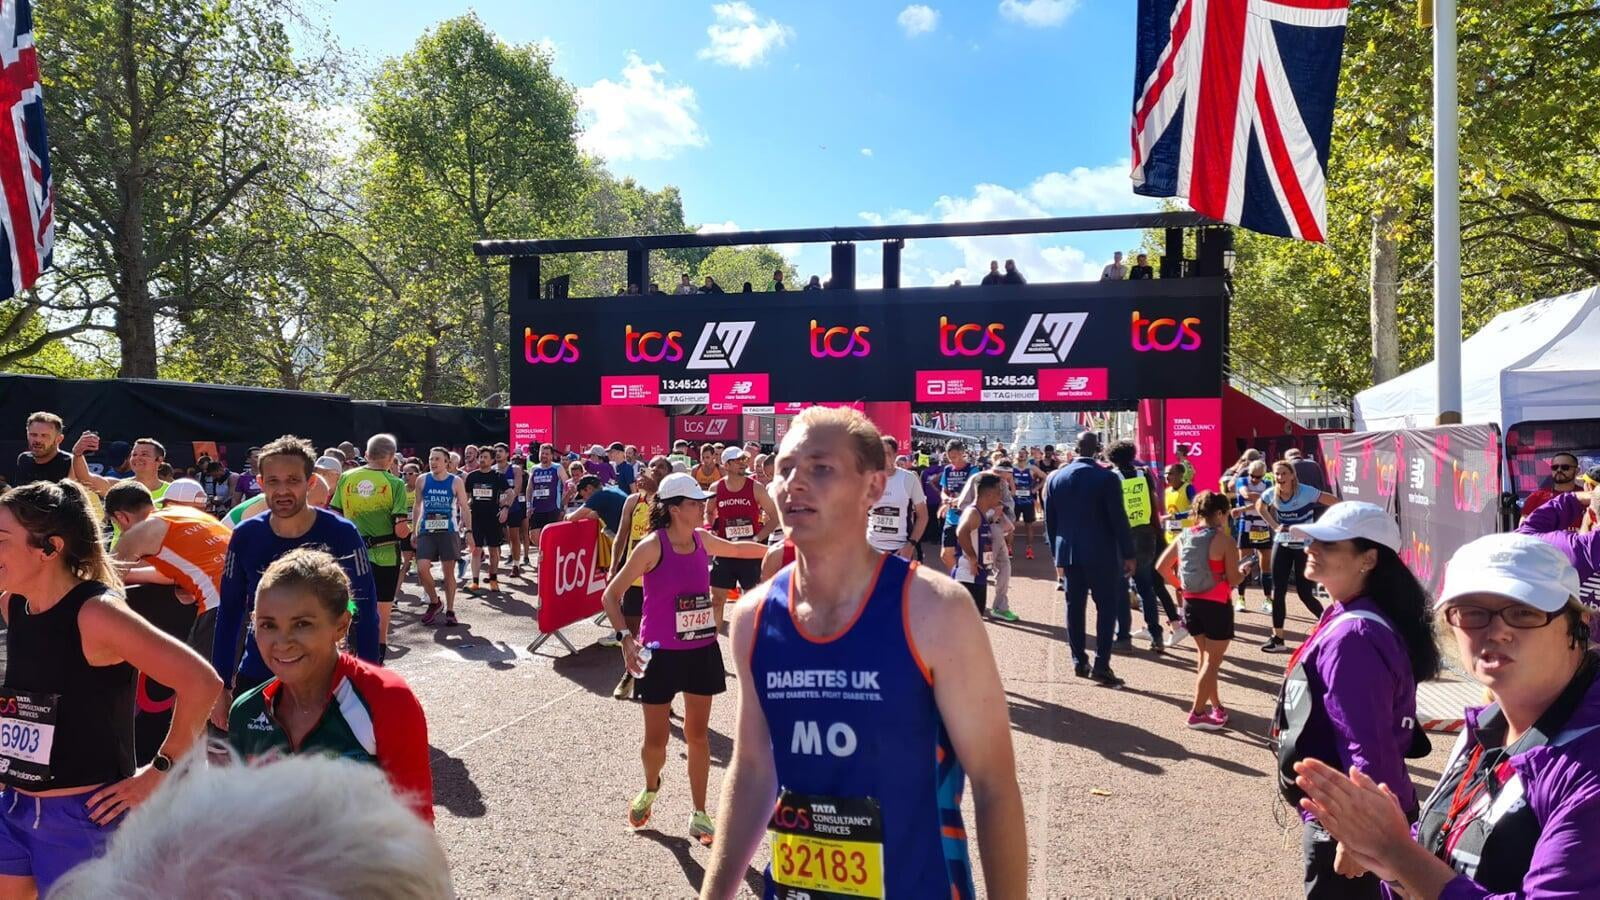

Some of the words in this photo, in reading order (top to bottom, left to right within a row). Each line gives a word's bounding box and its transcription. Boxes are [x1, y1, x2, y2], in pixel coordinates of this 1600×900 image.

[810, 319, 871, 358] tcs
[939, 316, 1005, 356] tcs
[1131, 311, 1201, 351] tcs
[524, 327, 580, 364] tcs
[625, 325, 684, 362] tcs
[662, 379, 707, 389] 13:45:26
[984, 375, 1035, 386] 13:45:26
[684, 420, 704, 433] tcs
[515, 441, 529, 456] tc
[1453, 459, 1481, 513] tcs
[555, 546, 586, 596] tcs
[682, 611, 711, 627] 37487
[767, 670, 847, 689] DiABETES
[851, 671, 880, 690] UK
[16, 695, 31, 703] TATA
[767, 691, 785, 699] KNOW
[786, 690, 821, 699] DIABETES.
[821, 691, 841, 699] FIGHT
[842, 691, 883, 701] DIABETES.
[0, 697, 17, 714] cs
[17, 703, 52, 714] CONSULTANCY
[19, 710, 39, 719] SERVICES
[791, 720, 857, 757] MO
[16, 770, 41, 781] balance
[774, 801, 810, 829] tcs
[810, 804, 837, 814] TATA
[812, 814, 873, 826] CONSULTANCY
[813, 824, 852, 835] SERVICES
[780, 842, 868, 885] 32183
